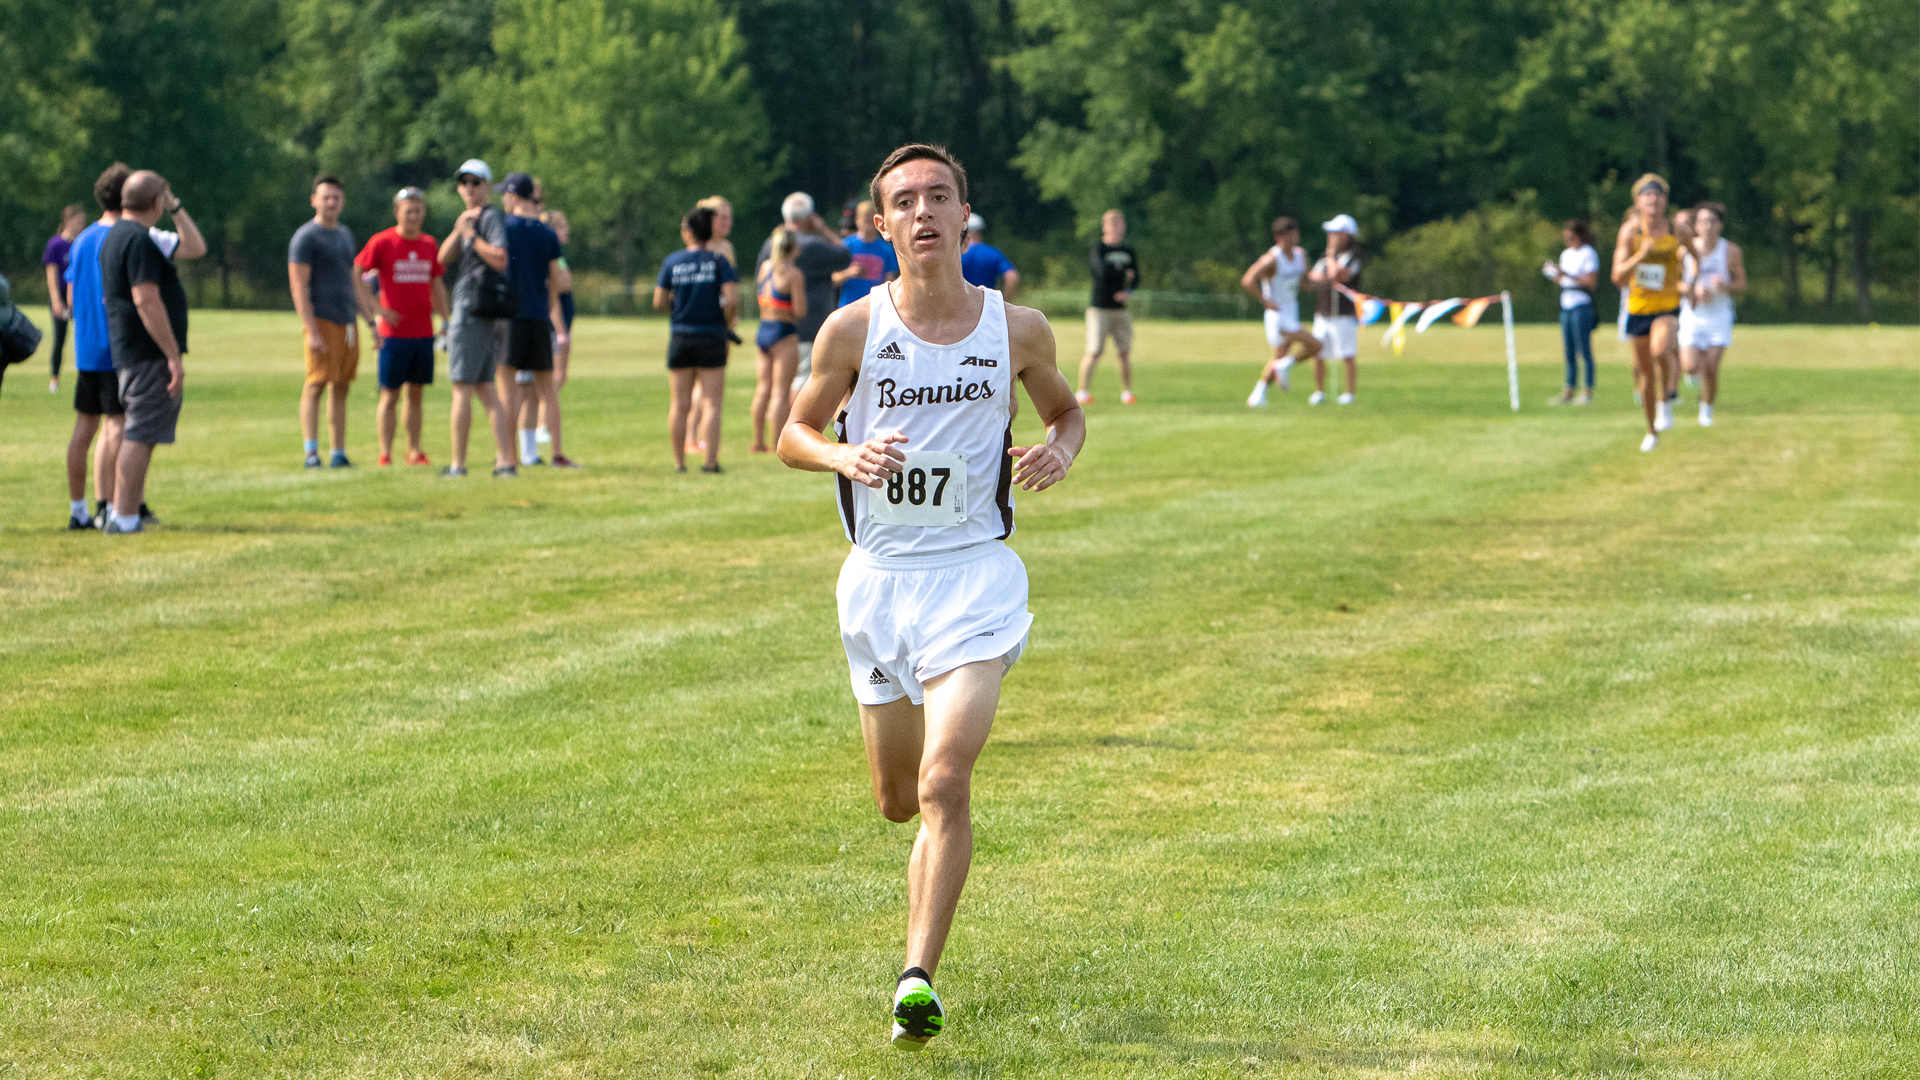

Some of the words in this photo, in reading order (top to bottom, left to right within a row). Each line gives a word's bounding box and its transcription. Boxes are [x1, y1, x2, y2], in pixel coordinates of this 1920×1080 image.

[877, 351, 906, 361] adidas
[959, 355, 998, 368] A10
[877, 377, 997, 409] Bonnies
[886, 467, 951, 507] 887
